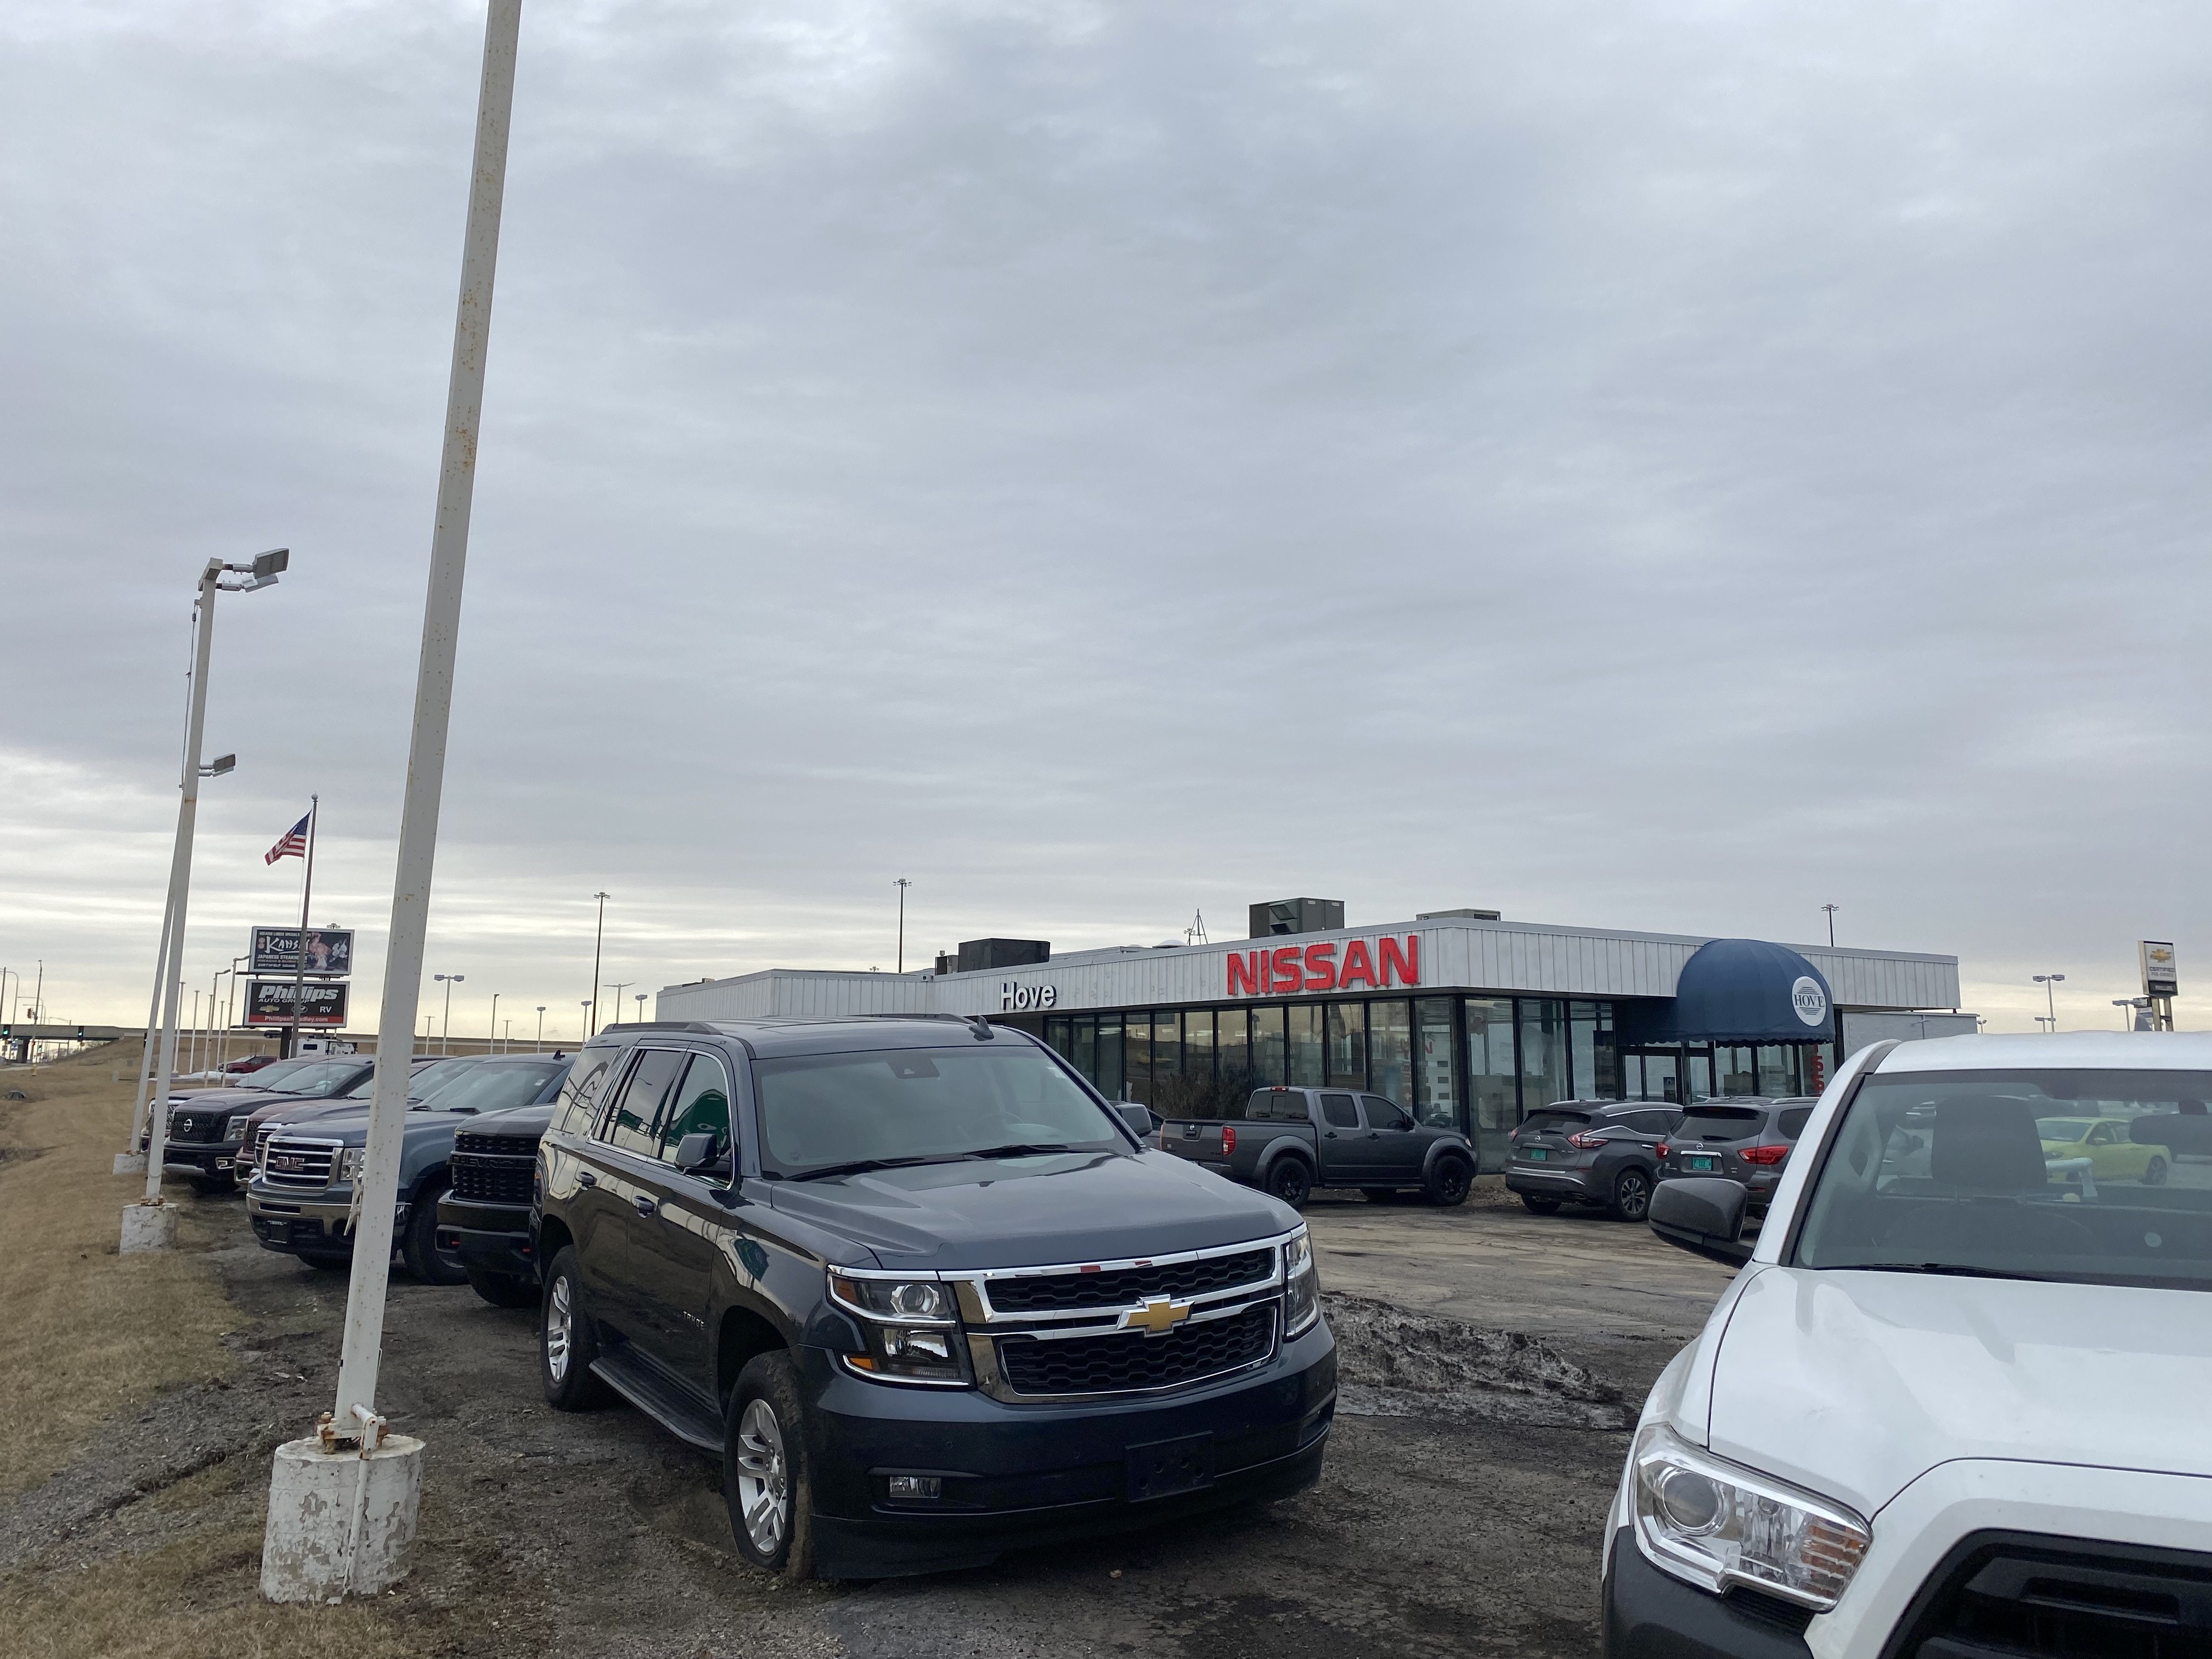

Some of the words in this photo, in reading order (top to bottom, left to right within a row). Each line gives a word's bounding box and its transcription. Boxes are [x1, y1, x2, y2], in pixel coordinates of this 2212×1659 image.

[264, 936, 310, 954] KANSI
[1227, 935, 1420, 995] NISSAN
[1000, 981, 1057, 1010] Hove
[1794, 994, 1825, 1008] HOVE
[275, 1156, 305, 1172] GMC
[683, 1311, 706, 1331] TAHOE
